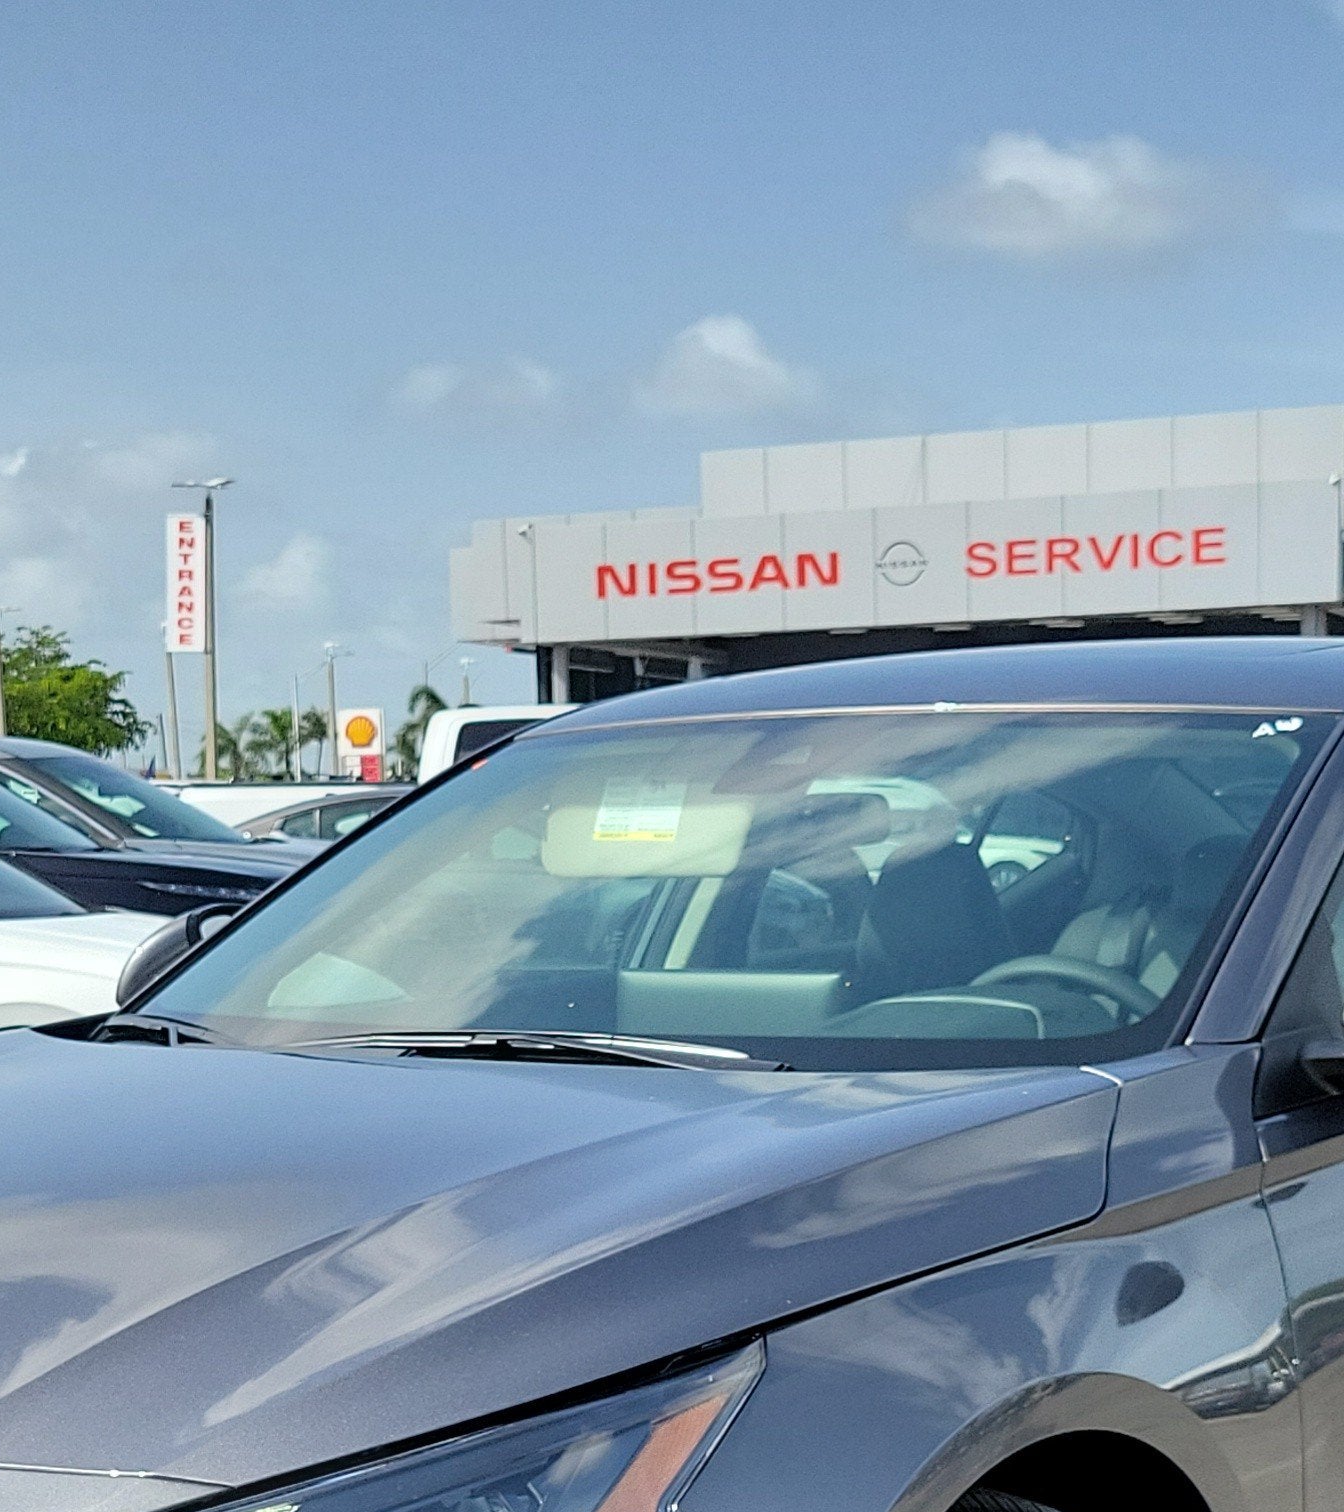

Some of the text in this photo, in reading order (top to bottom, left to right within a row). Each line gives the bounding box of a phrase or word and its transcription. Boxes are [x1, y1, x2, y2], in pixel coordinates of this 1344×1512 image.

[598, 552, 839, 599] NISSAN
[964, 527, 1227, 578] SERVICE
[177, 521, 194, 645] ENTRANCE
